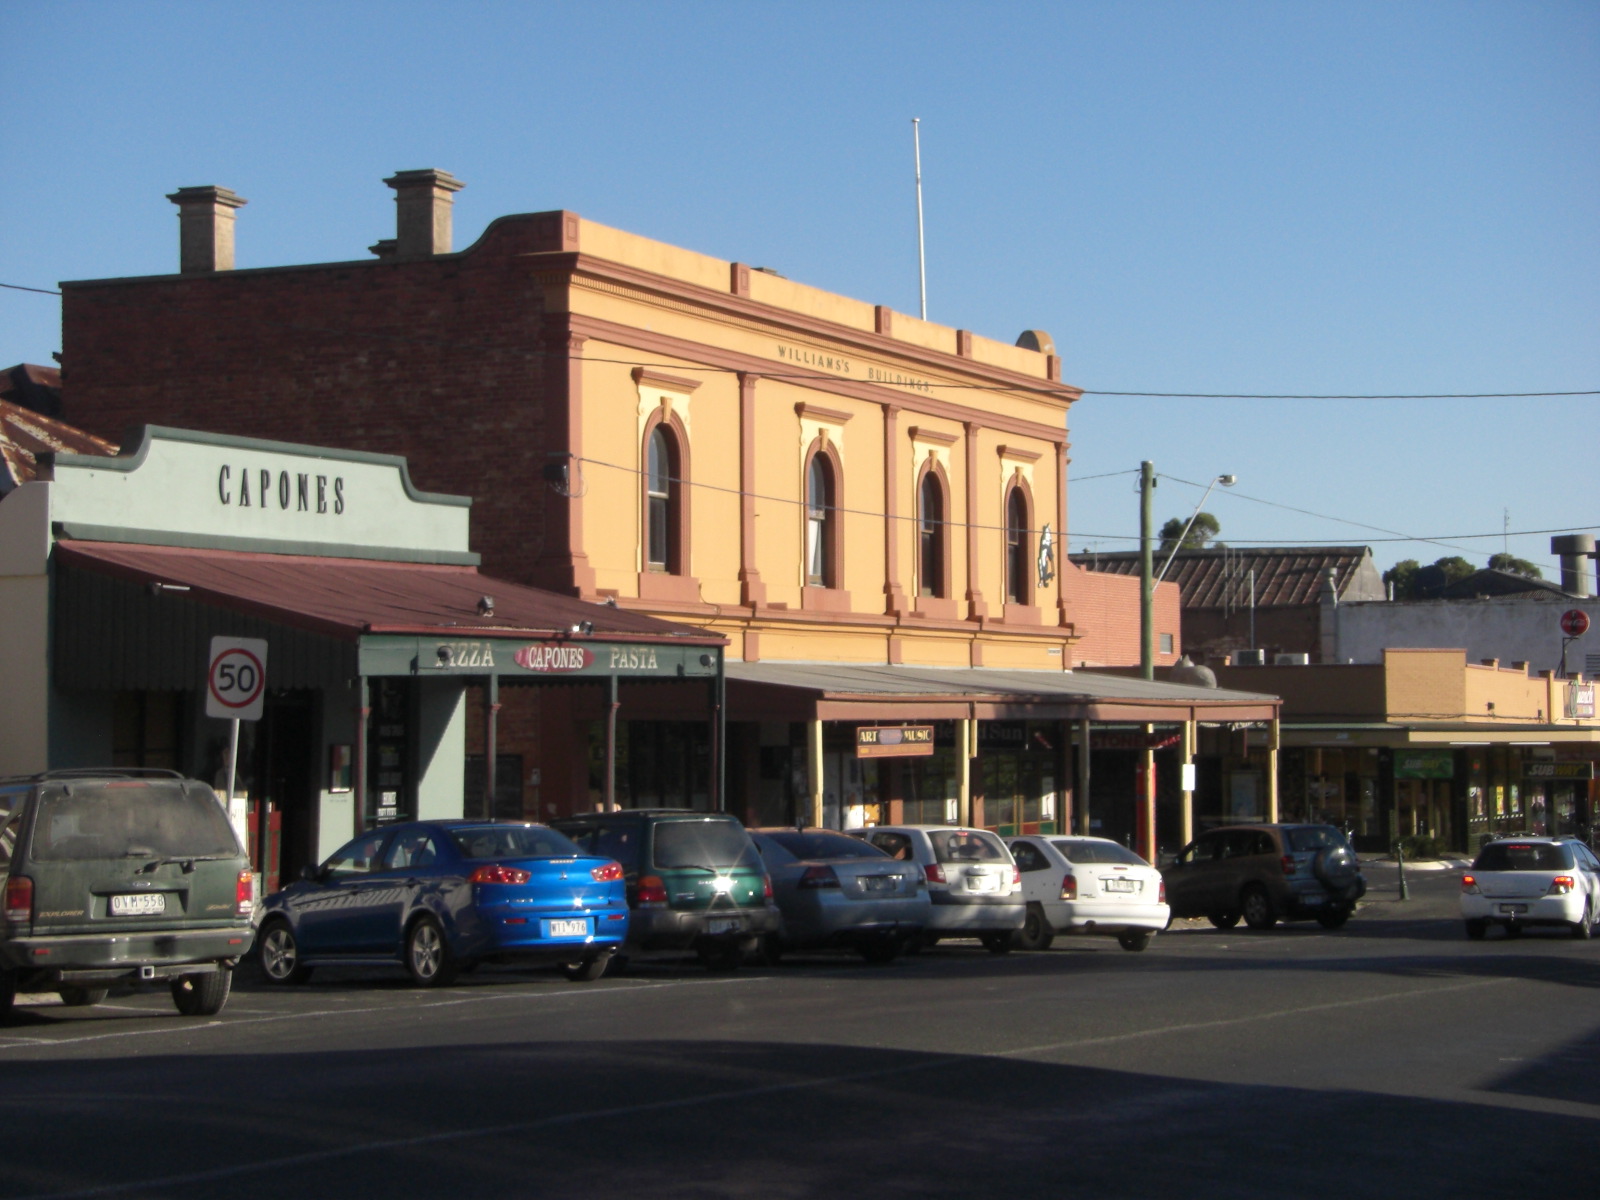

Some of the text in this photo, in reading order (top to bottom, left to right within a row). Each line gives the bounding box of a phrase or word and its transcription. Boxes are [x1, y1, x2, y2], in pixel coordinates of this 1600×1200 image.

[777, 344, 850, 373] WILLIAMS'S
[218, 464, 344, 515] CAPONES
[528, 647, 584, 669] CAPONES
[610, 646, 658, 669] PASTA
[219, 664, 255, 693] 50
[860, 730, 877, 742] ART
[904, 729, 930, 741] MUSIC
[1528, 764, 1584, 776] SUBWAY
